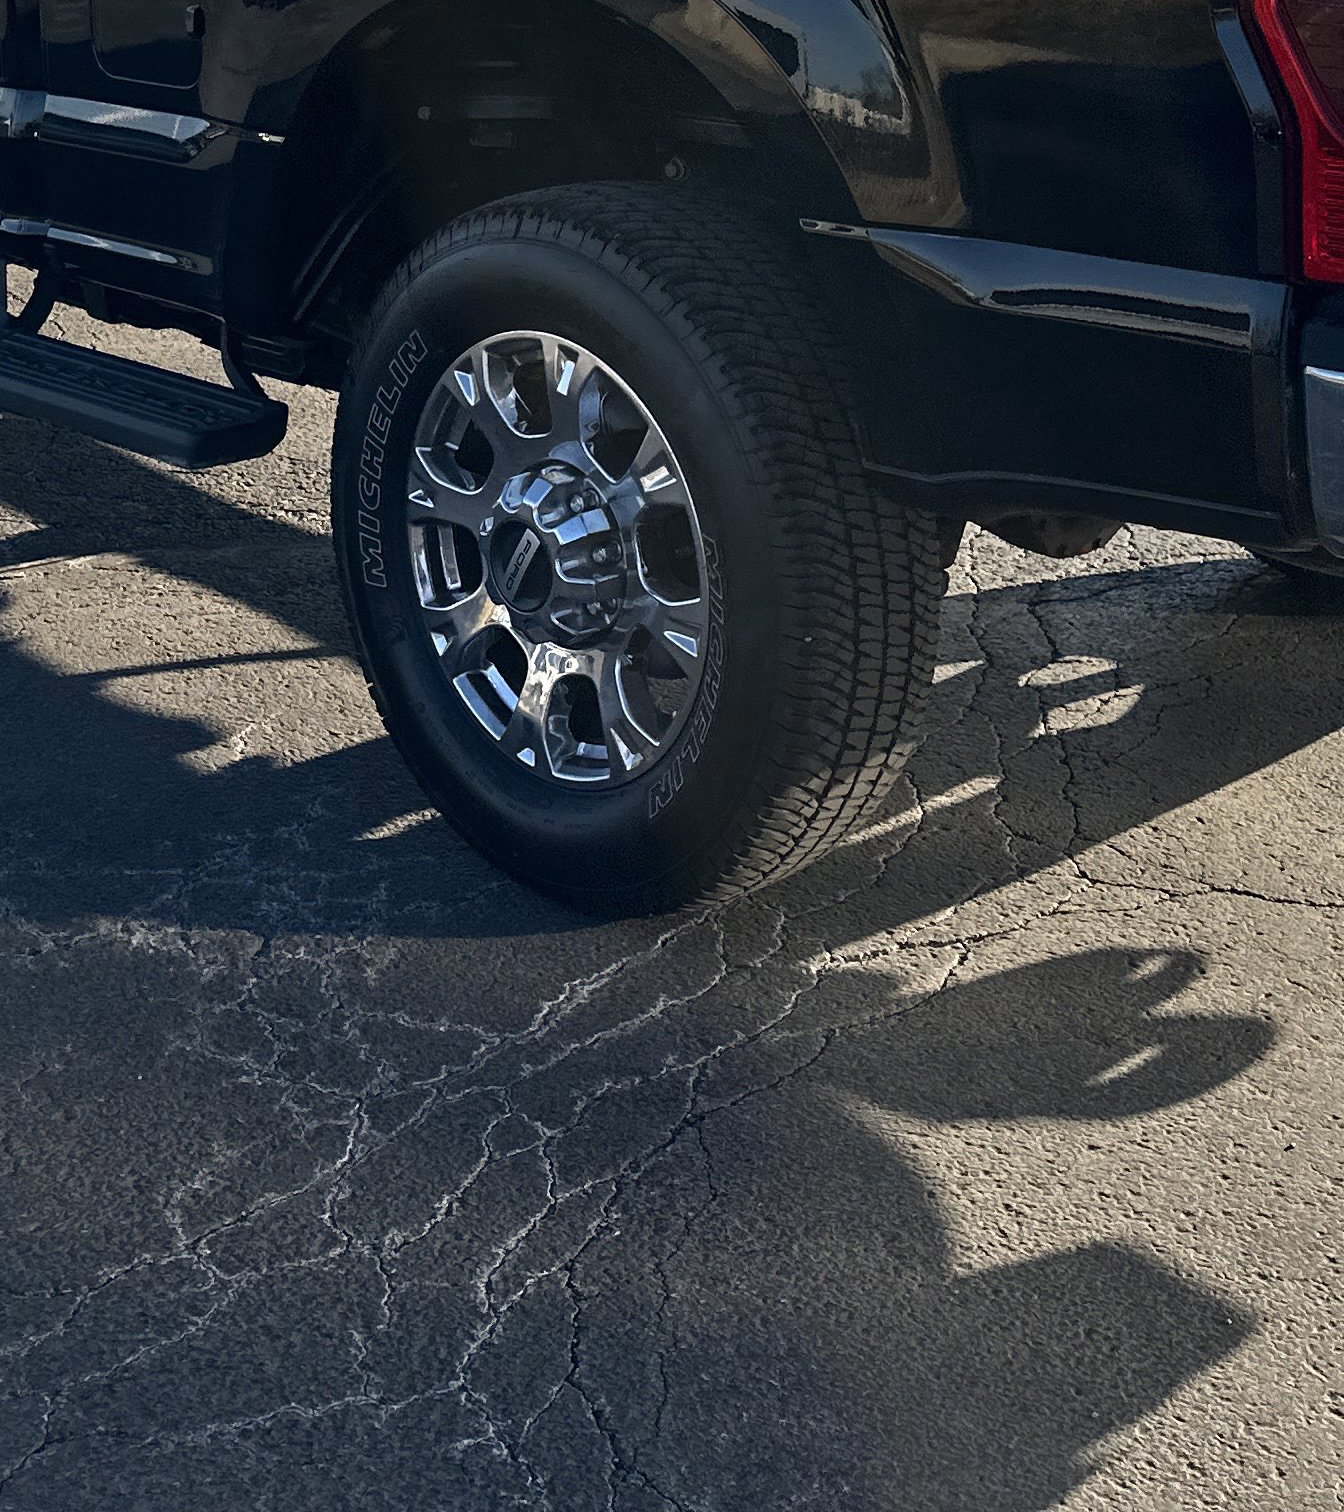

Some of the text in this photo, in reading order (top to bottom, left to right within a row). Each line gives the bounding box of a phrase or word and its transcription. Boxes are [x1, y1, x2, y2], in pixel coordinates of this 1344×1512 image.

[358, 329, 428, 588] MICHELIN
[506, 539, 532, 591] FORD
[646, 533, 725, 819] MICHELIN
